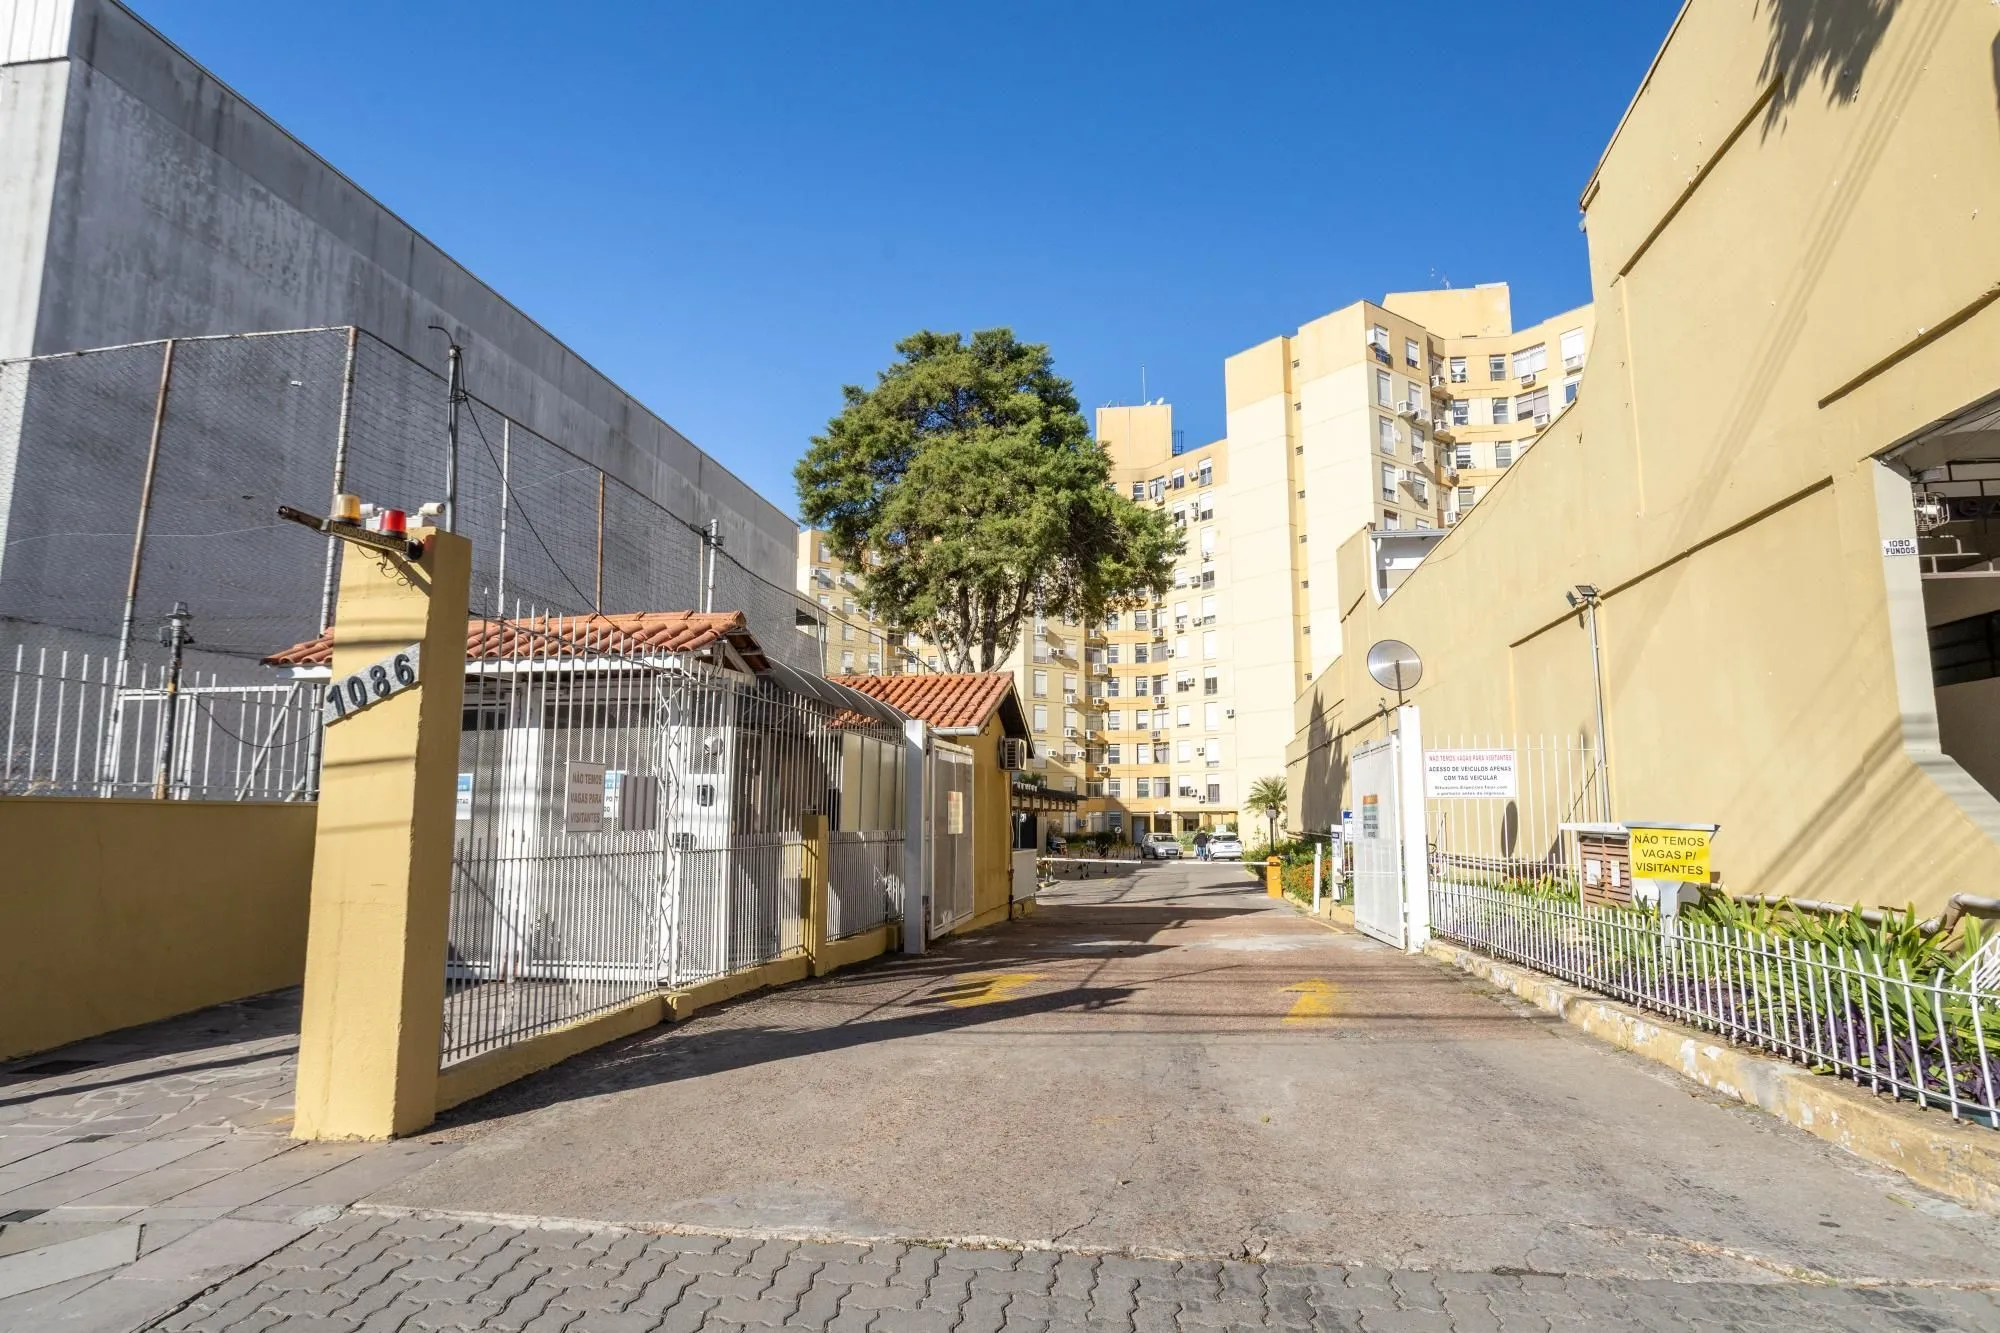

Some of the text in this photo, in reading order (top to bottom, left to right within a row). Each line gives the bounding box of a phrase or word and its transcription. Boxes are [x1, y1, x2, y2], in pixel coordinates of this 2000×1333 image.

[1885, 547, 1916, 555] FUNDOS
[326, 653, 415, 717] 1086
[572, 771, 584, 784] NÃO
[585, 774, 602, 785] TEMOS
[570, 792, 602, 804] VAGAS PARA
[570, 811, 601, 824] VISITANTES
[1634, 833, 1705, 847] NÃO TEMOS
[1641, 848, 1697, 860] VAGAS P/
[1635, 862, 1704, 876] VISITANTES
